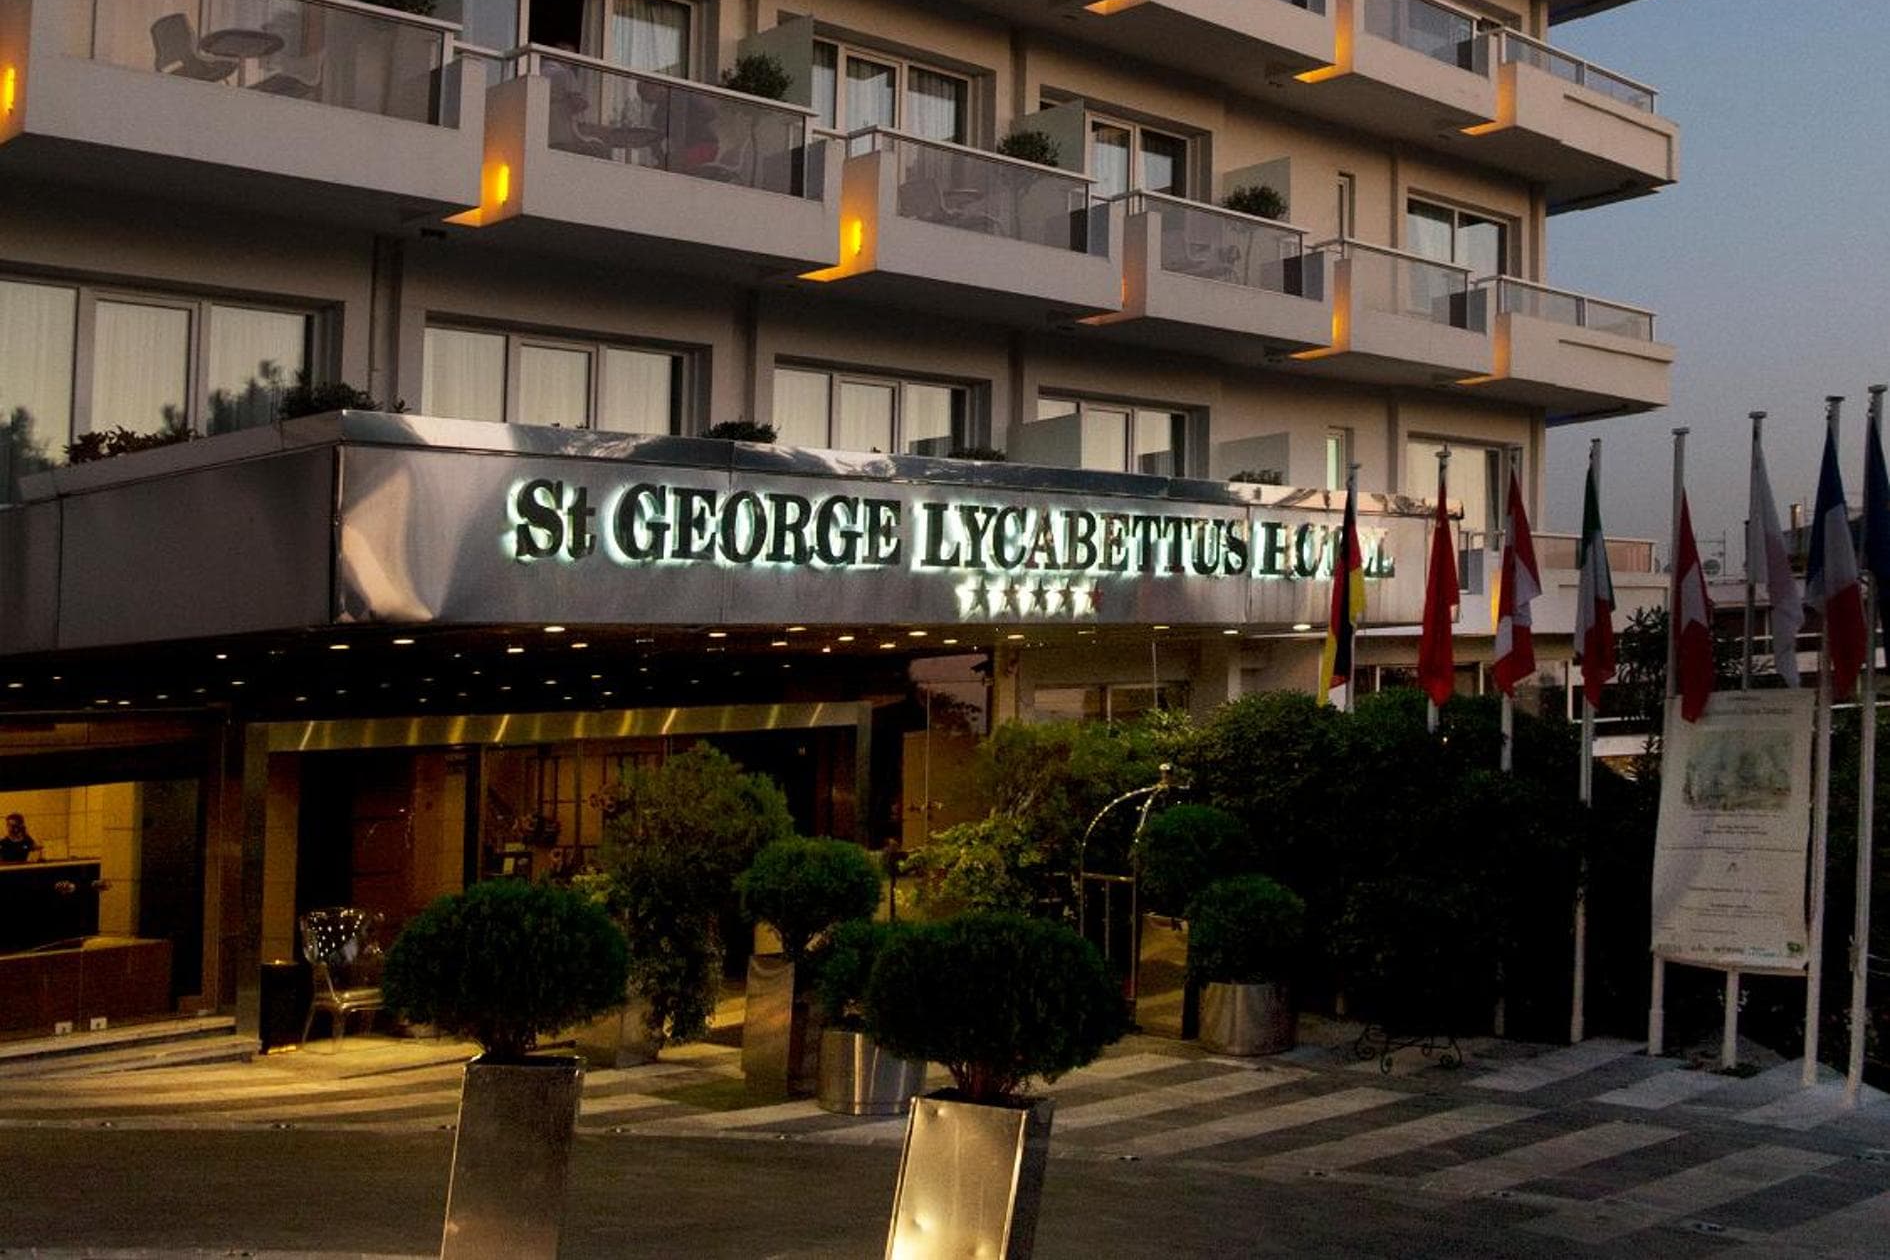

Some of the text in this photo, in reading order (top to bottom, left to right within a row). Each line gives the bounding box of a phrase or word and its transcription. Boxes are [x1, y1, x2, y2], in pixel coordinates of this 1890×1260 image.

[516, 478, 1396, 578] St GEORGE LYCABETTUS HOTL
